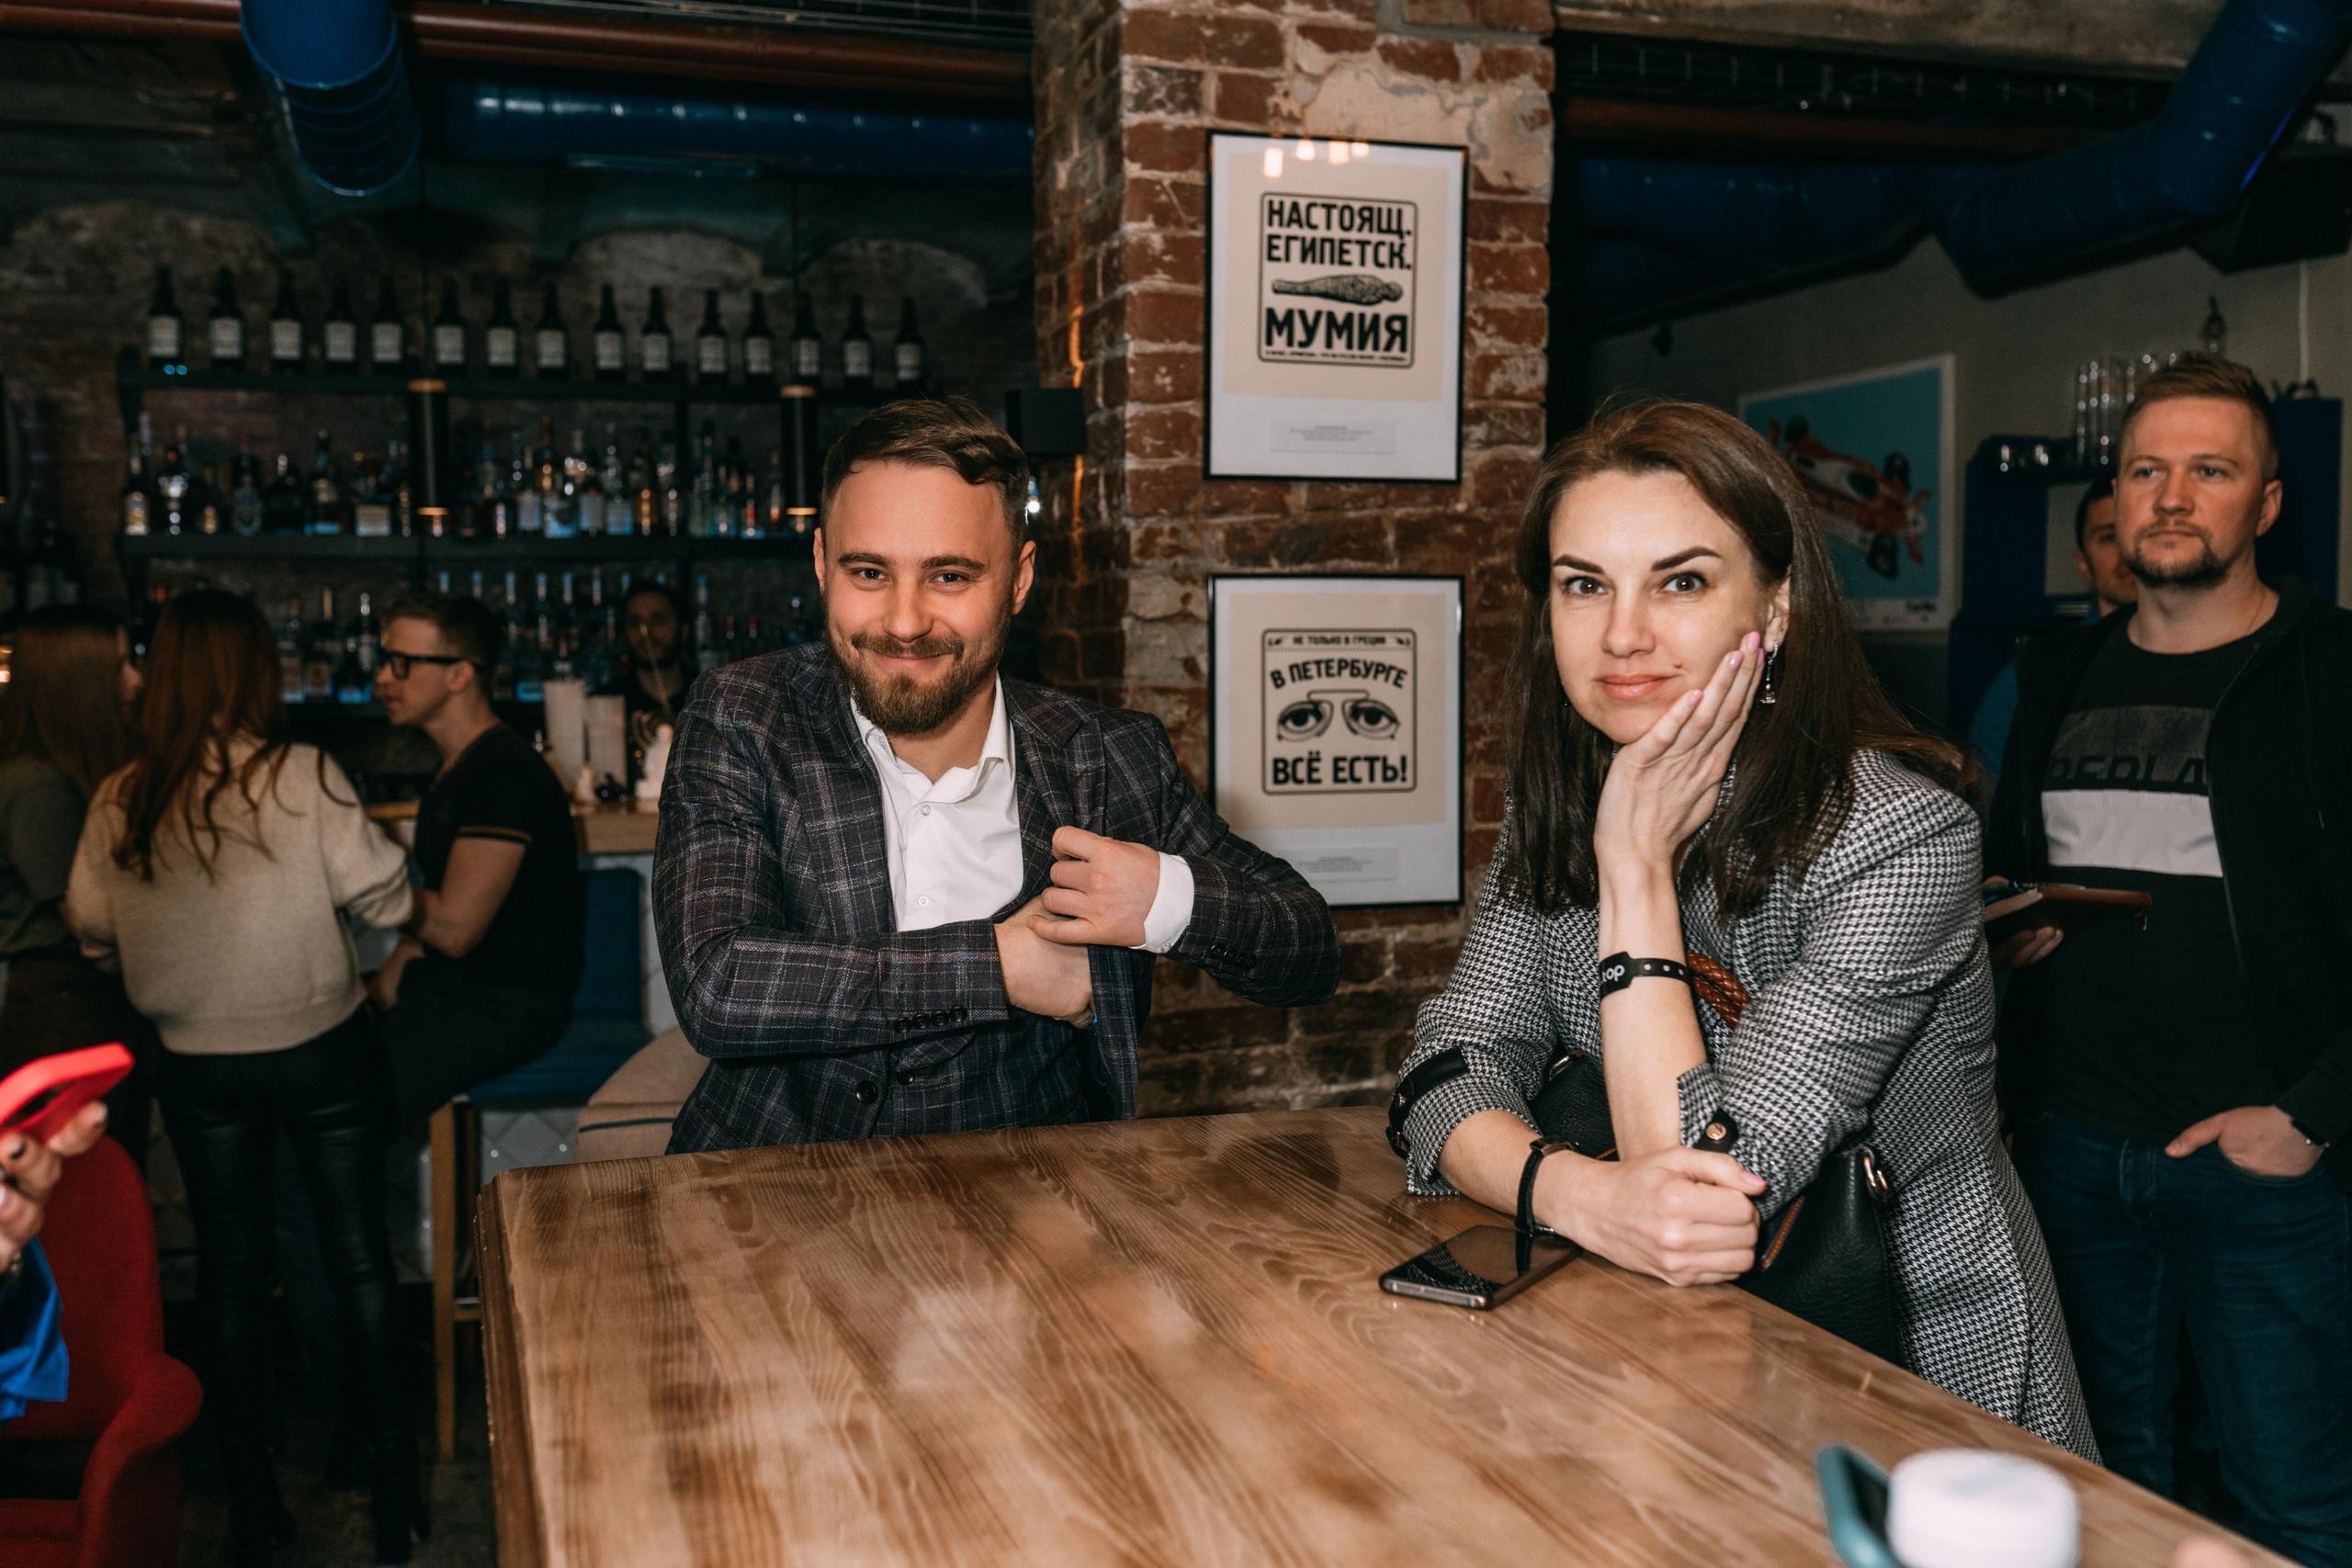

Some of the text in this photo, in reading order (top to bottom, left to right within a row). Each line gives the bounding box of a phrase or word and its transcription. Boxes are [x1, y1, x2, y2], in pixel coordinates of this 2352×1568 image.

[1268, 199, 1413, 237] НАСТОЯЩ.
[1267, 234, 1413, 270] ЕГИПЕТСК.
[1265, 307, 1408, 354] МУМИЯ
[1271, 658, 1408, 689] В ПЕТЕРБУРГЕ
[1272, 750, 1408, 785] ВСЁ ЕСТЬ!
